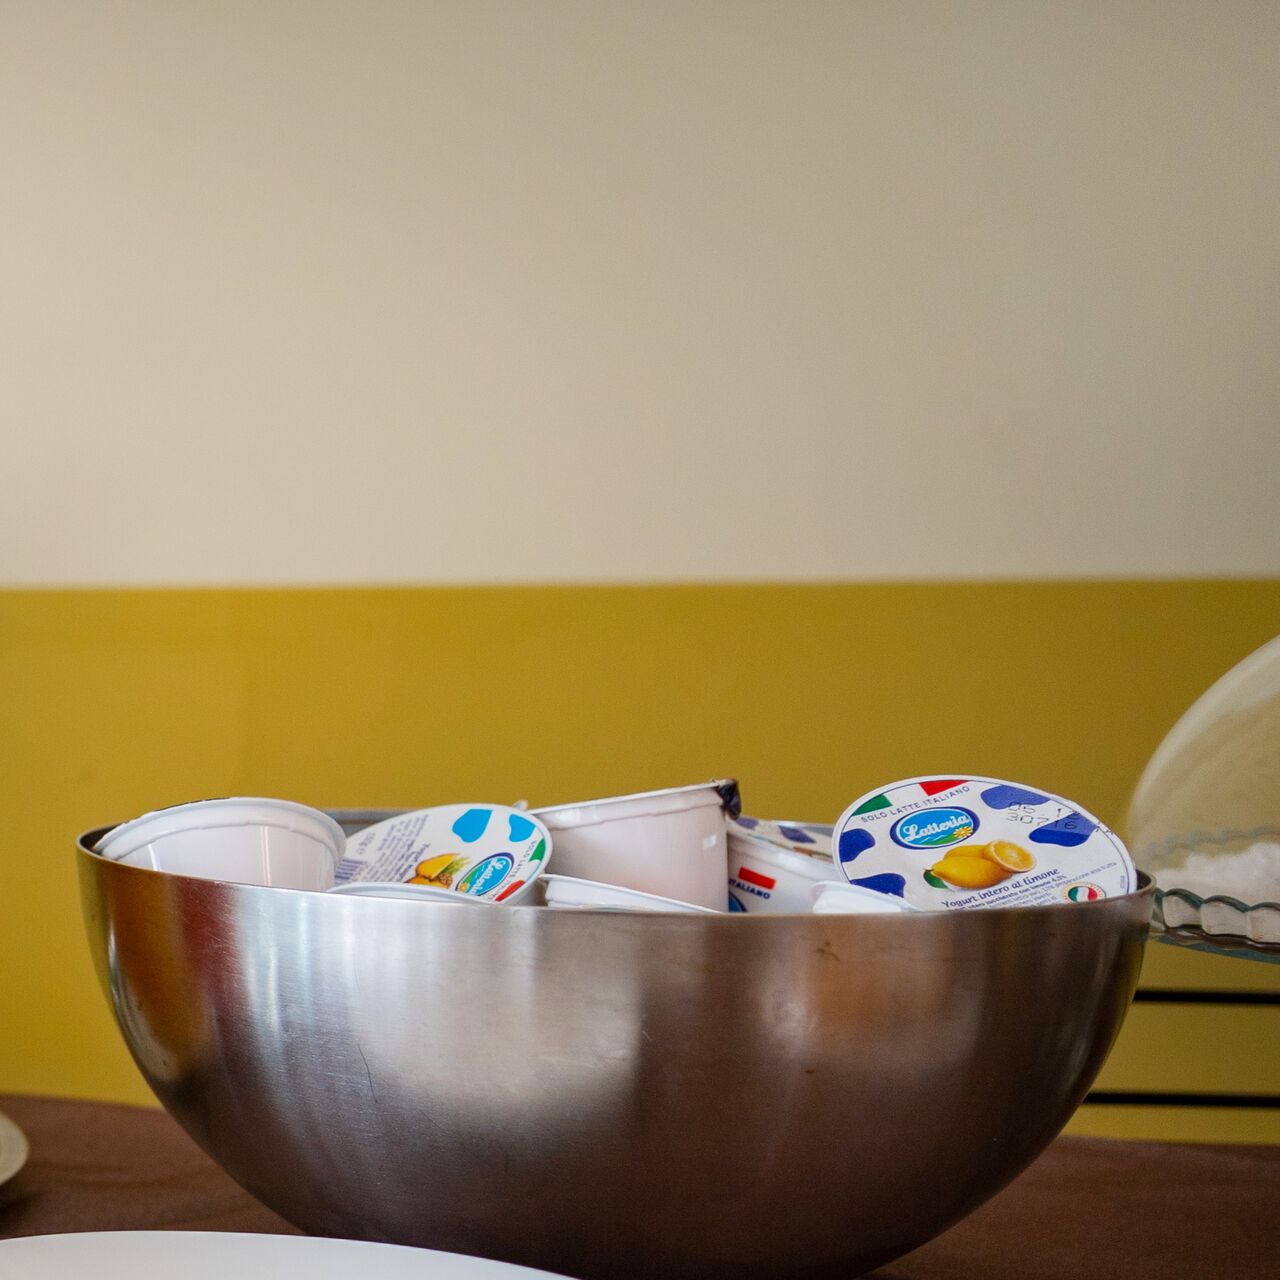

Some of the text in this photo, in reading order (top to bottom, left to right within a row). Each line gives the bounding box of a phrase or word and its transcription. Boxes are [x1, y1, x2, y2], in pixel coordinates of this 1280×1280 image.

[860, 786, 970, 823] SOLO LATTE ITALIANO
[902, 815, 970, 842] Latteria
[942, 895, 978, 908] Yogurt
[978, 886, 1010, 900] intero
[1011, 880, 1023, 889] al
[1023, 868, 1060, 884] limone
